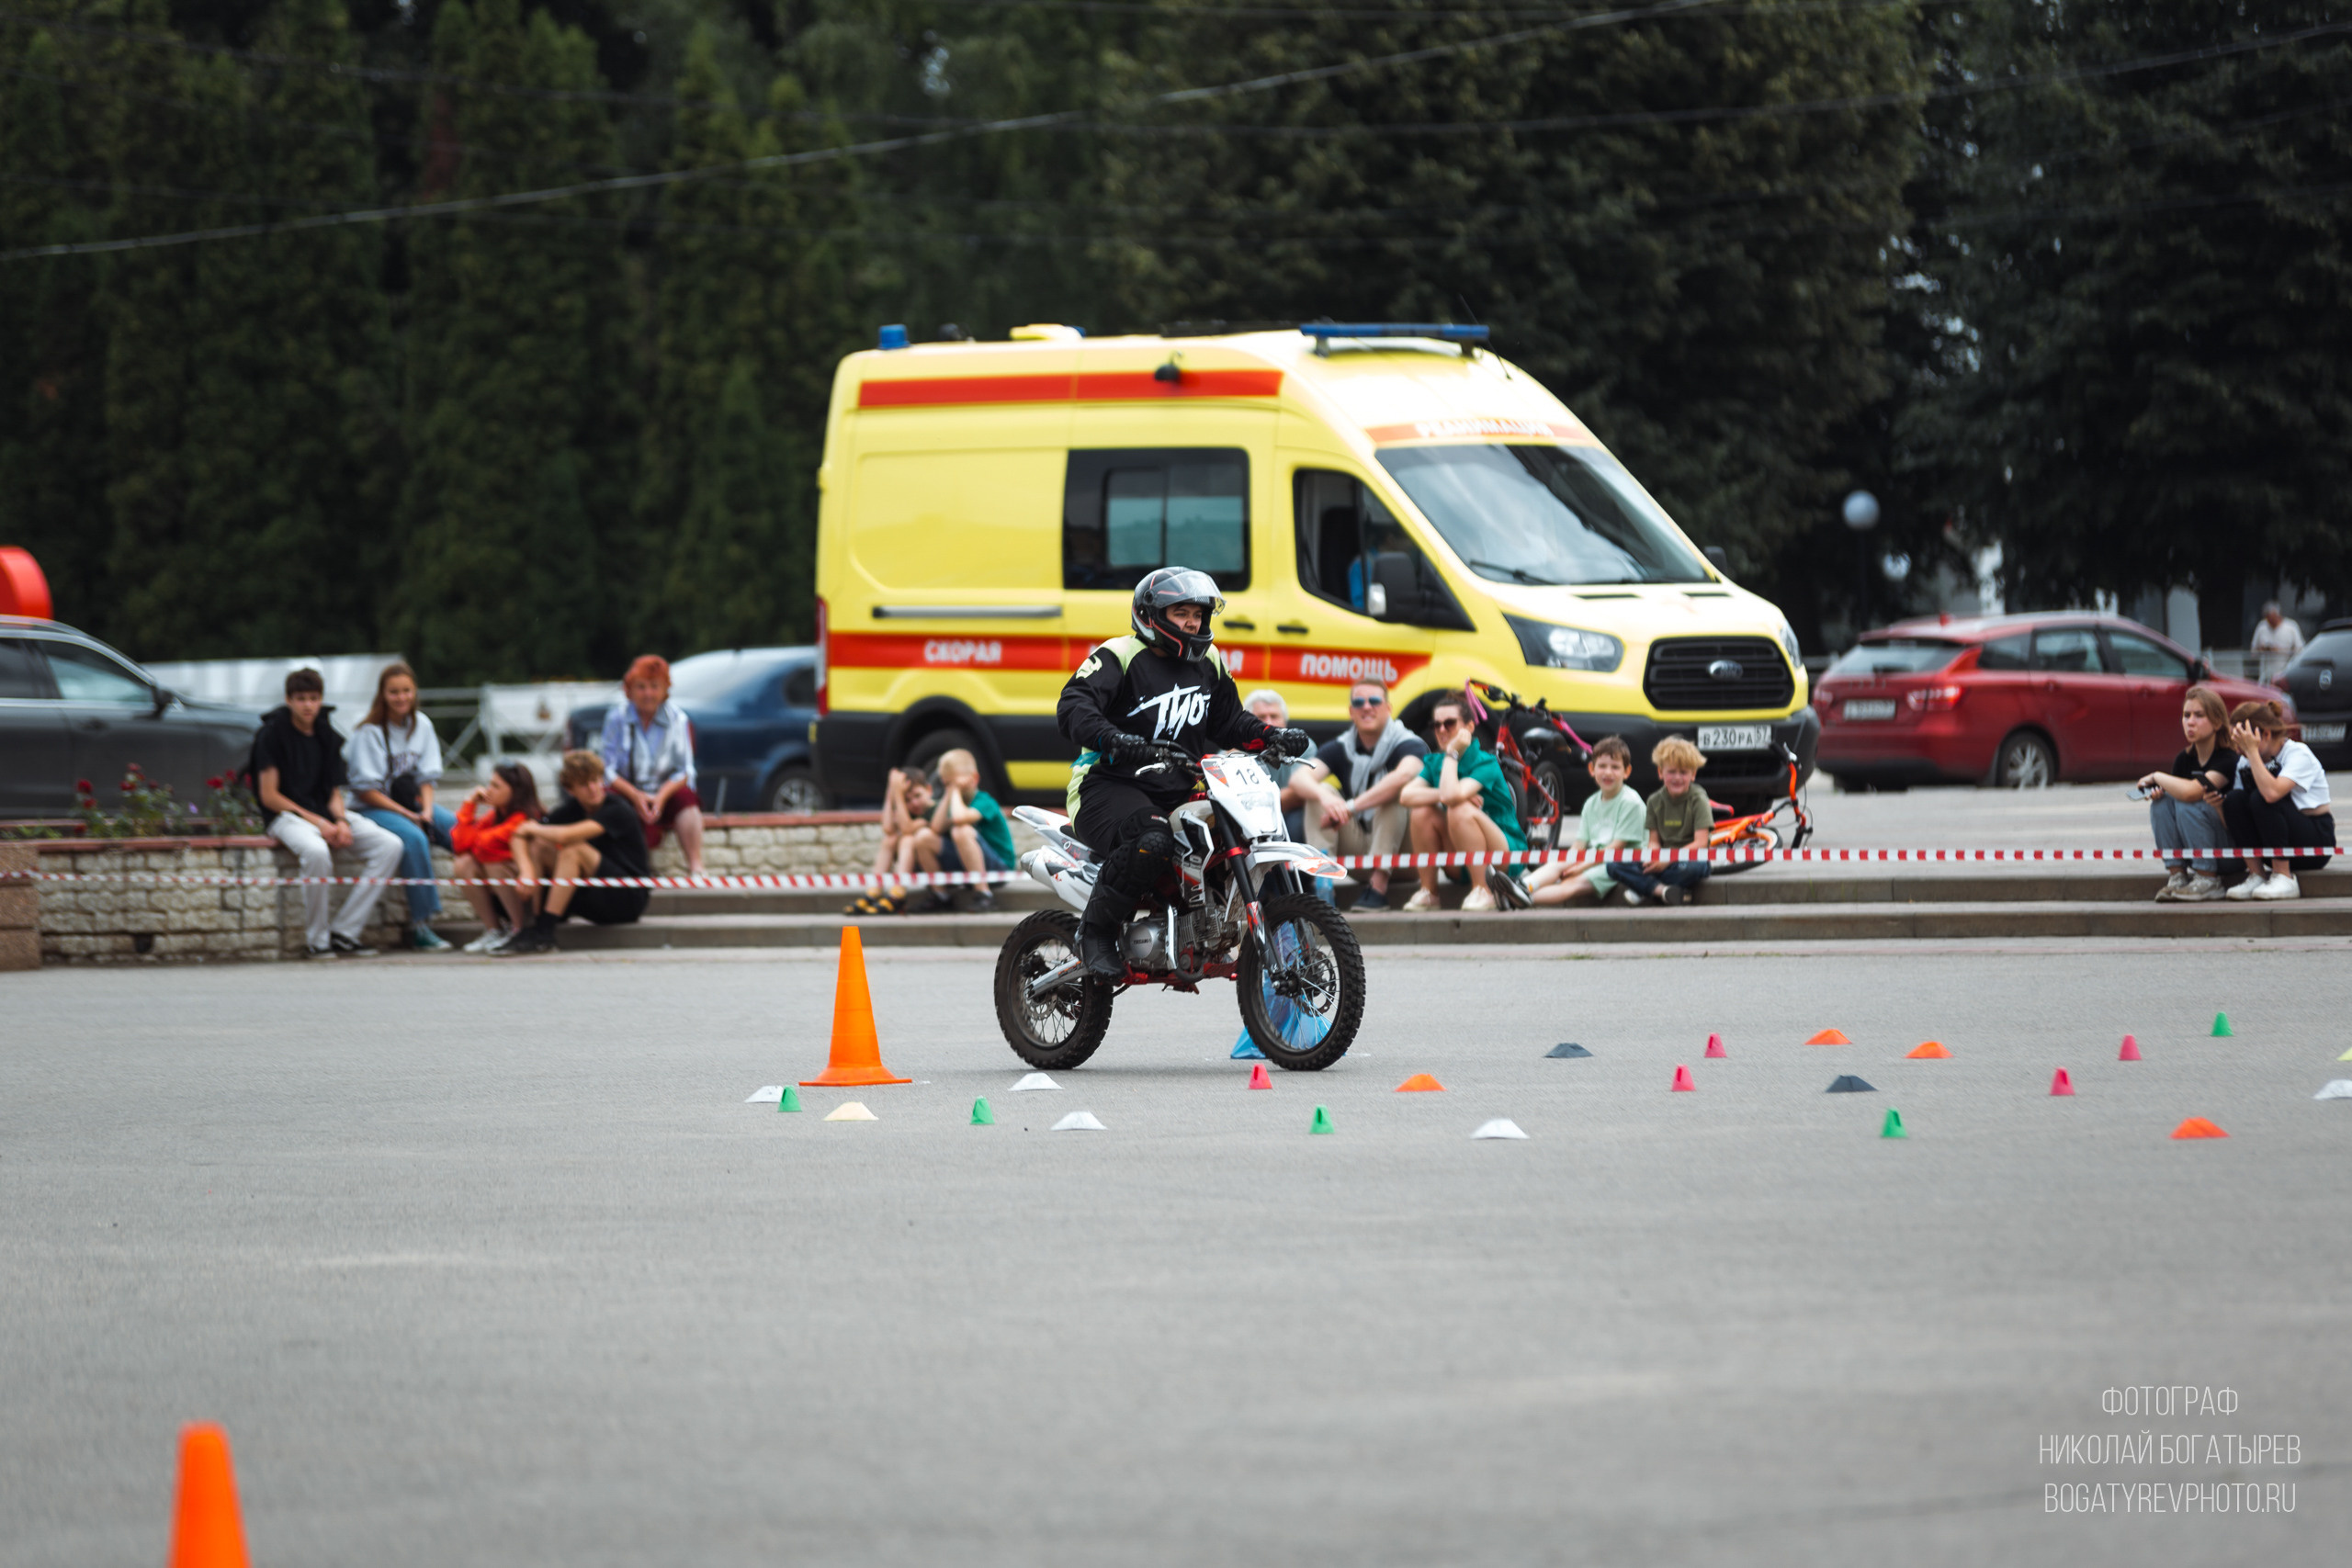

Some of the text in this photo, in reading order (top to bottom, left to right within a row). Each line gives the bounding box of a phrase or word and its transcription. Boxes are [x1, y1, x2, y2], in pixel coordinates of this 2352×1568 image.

[924, 640, 1398, 682] СКОРАЯ ПОМОЩЬ
[1236, 768, 1260, 785] 18
